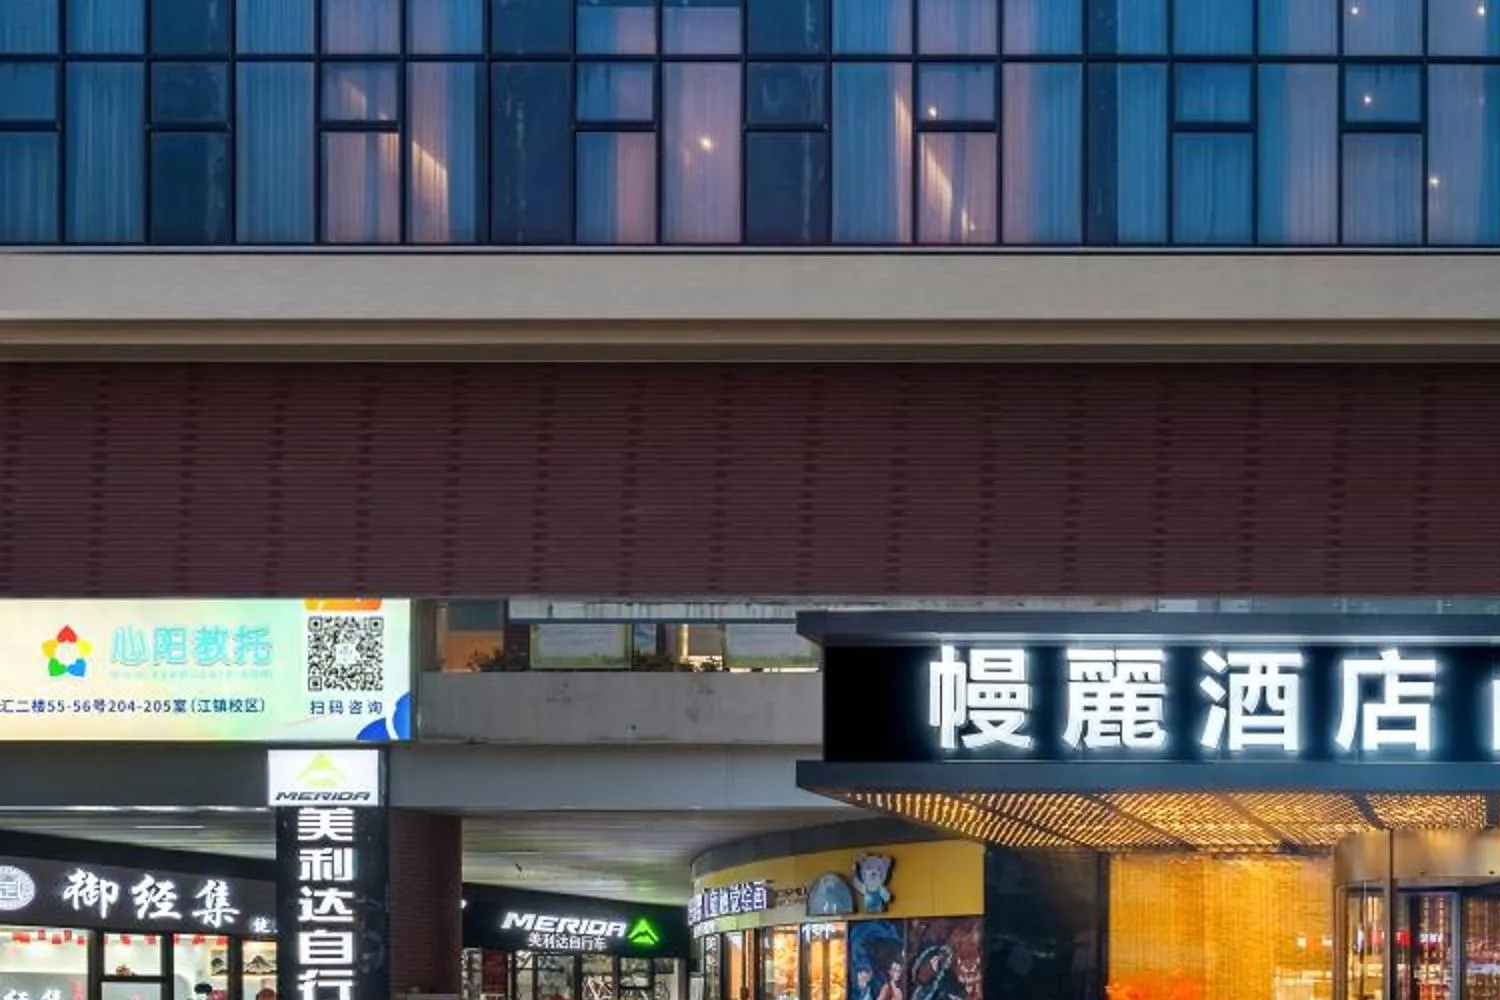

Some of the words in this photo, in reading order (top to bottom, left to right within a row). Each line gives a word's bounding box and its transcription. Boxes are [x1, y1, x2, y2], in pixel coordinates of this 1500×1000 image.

[110, 624, 274, 668] 心阳教托
[309, 700, 383, 716] 扫码咨询
[928, 645, 1438, 752] 幔麗酒店
[276, 791, 371, 801] MERIDA
[500, 911, 627, 937] MERIDA
[528, 931, 606, 950] 美利达自行车
